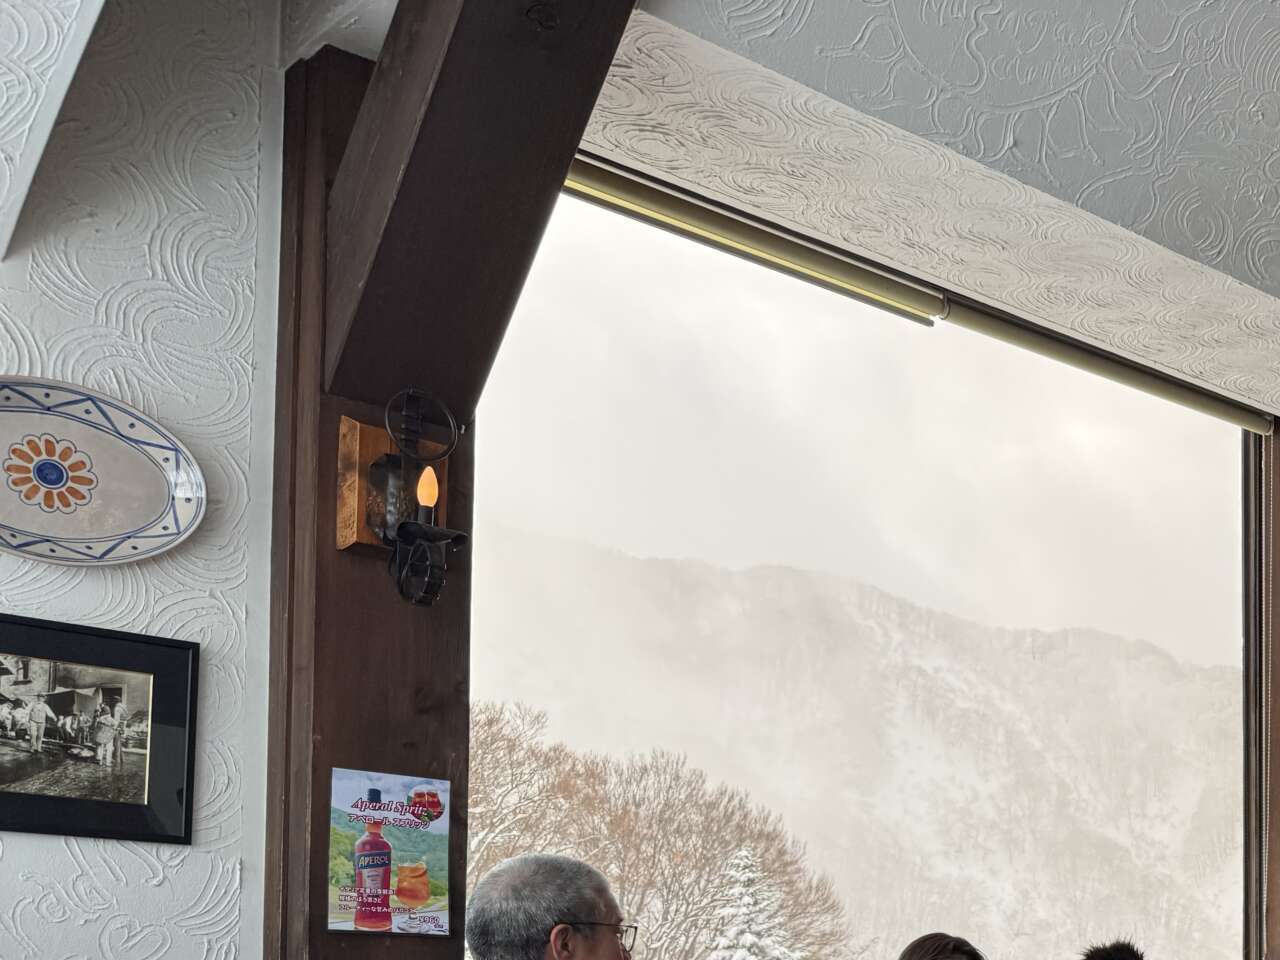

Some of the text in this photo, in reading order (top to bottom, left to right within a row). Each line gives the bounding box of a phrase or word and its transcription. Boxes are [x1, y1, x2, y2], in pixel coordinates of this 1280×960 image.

[351, 797, 429, 815] Aperol Spritz
[348, 813, 391, 826] アペロール
[359, 856, 389, 869] APEROL
